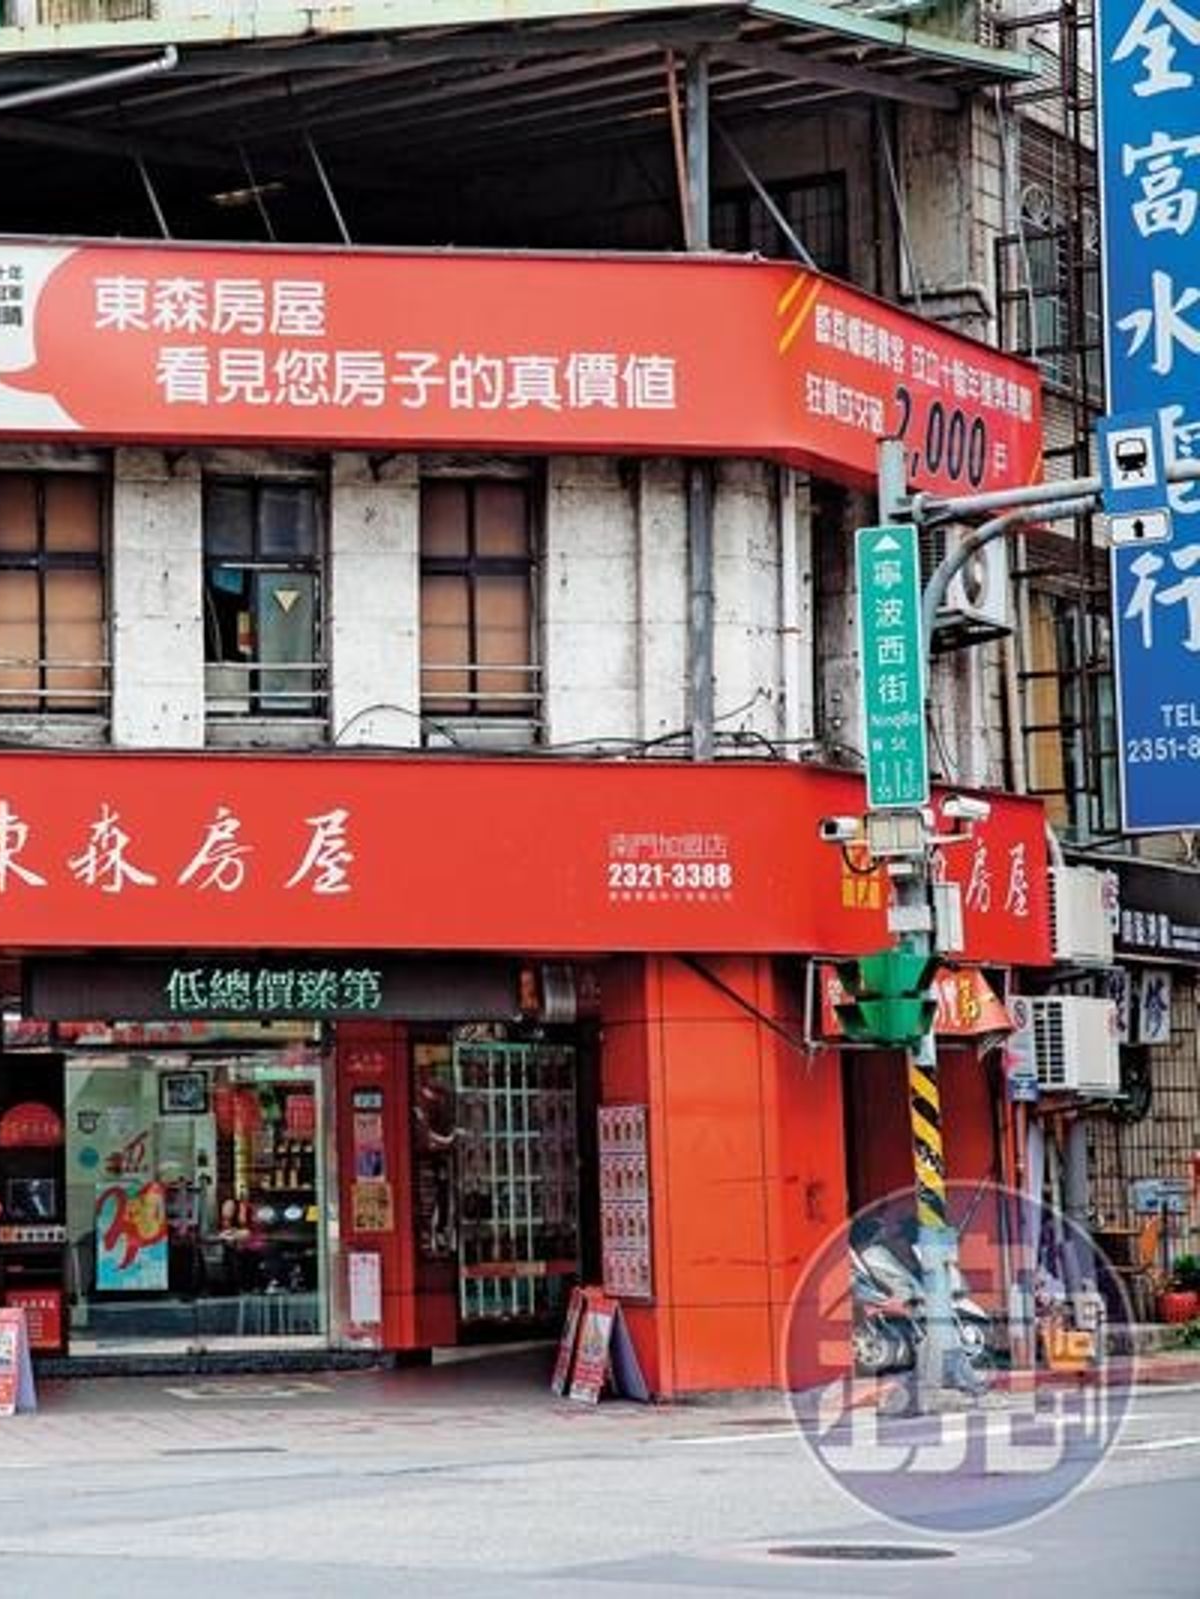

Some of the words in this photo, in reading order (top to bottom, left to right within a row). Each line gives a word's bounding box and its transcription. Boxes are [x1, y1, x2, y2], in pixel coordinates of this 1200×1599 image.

[94, 276, 326, 338] 東森房屋
[156, 346, 677, 411] 看見您房子的真價值
[872, 559, 909, 704] 寧波西街
[1161, 702, 1200, 728] TEL
[608, 862, 733, 889] 2321-3388
